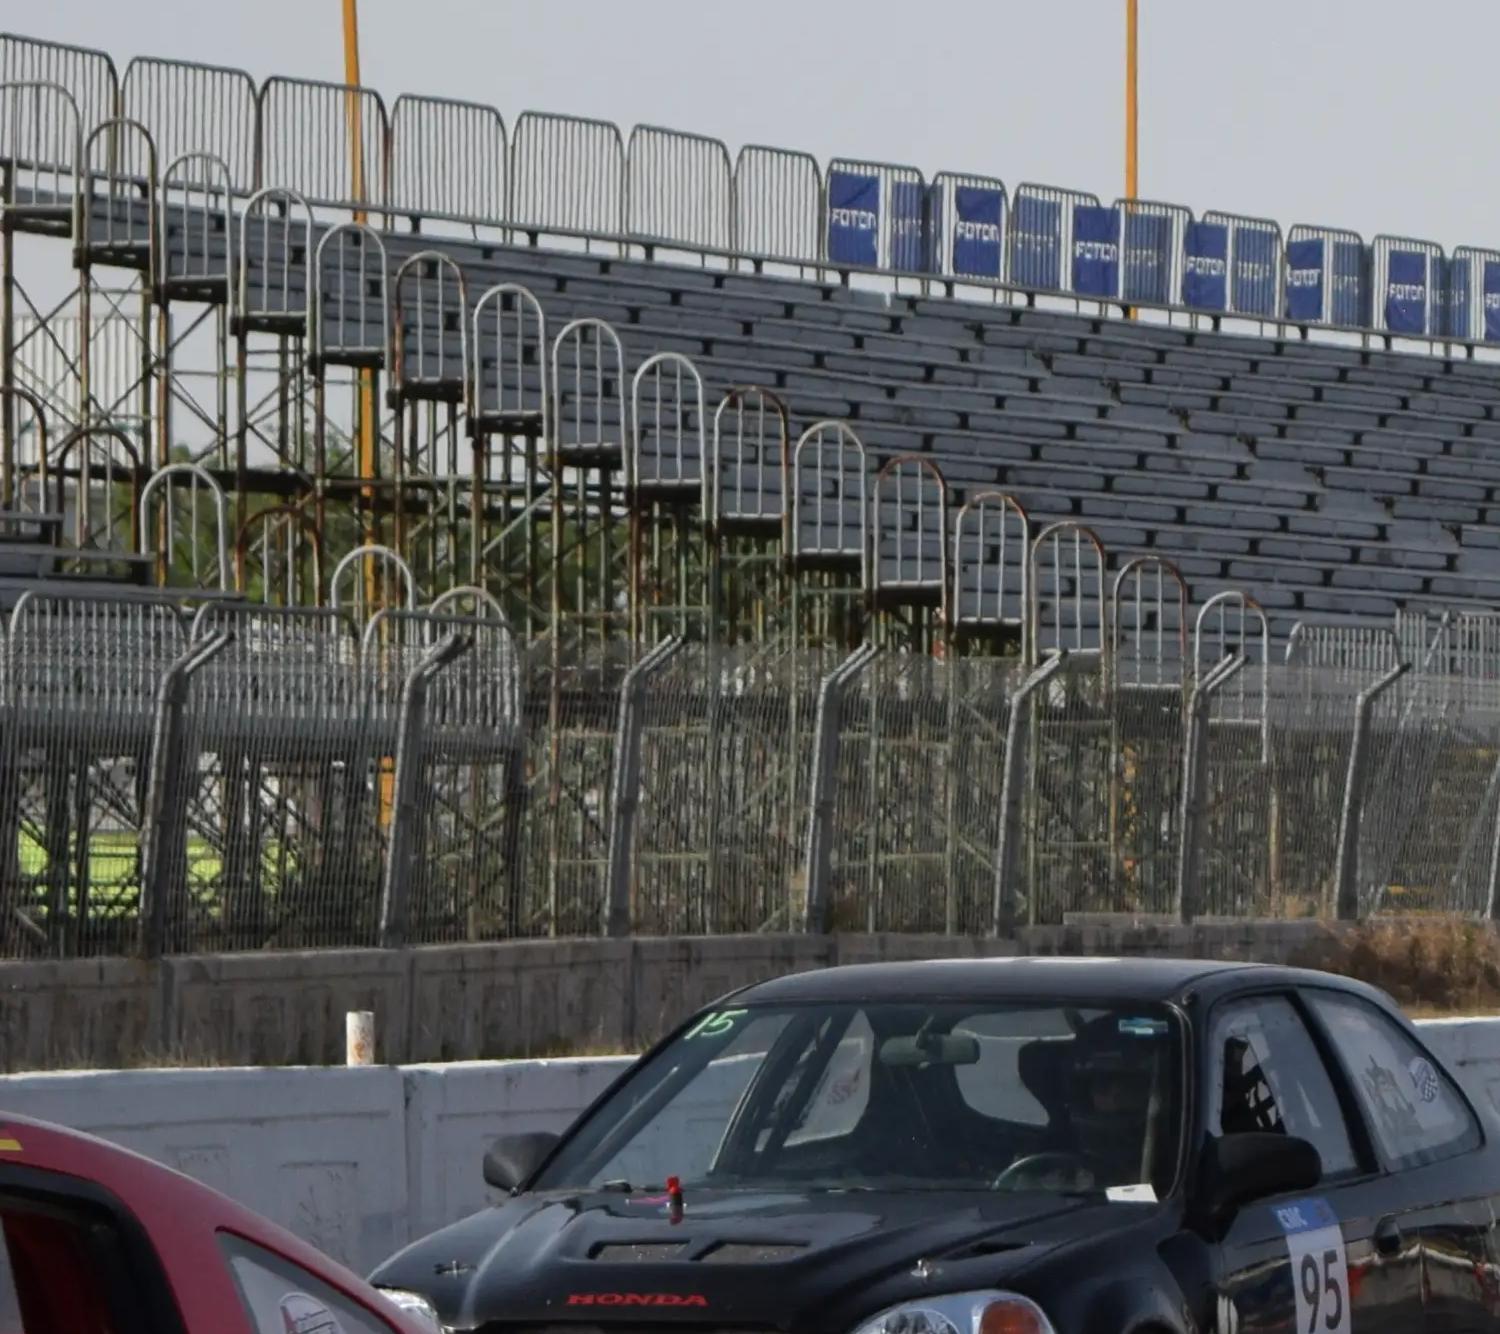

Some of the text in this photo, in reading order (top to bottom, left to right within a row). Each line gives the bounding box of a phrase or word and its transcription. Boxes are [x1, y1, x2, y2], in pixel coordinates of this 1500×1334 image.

[1388, 283, 1425, 300] FOTON
[683, 1008, 749, 1041] 15
[564, 1293, 709, 1306] HONDA
[1300, 1249, 1342, 1334] 95
